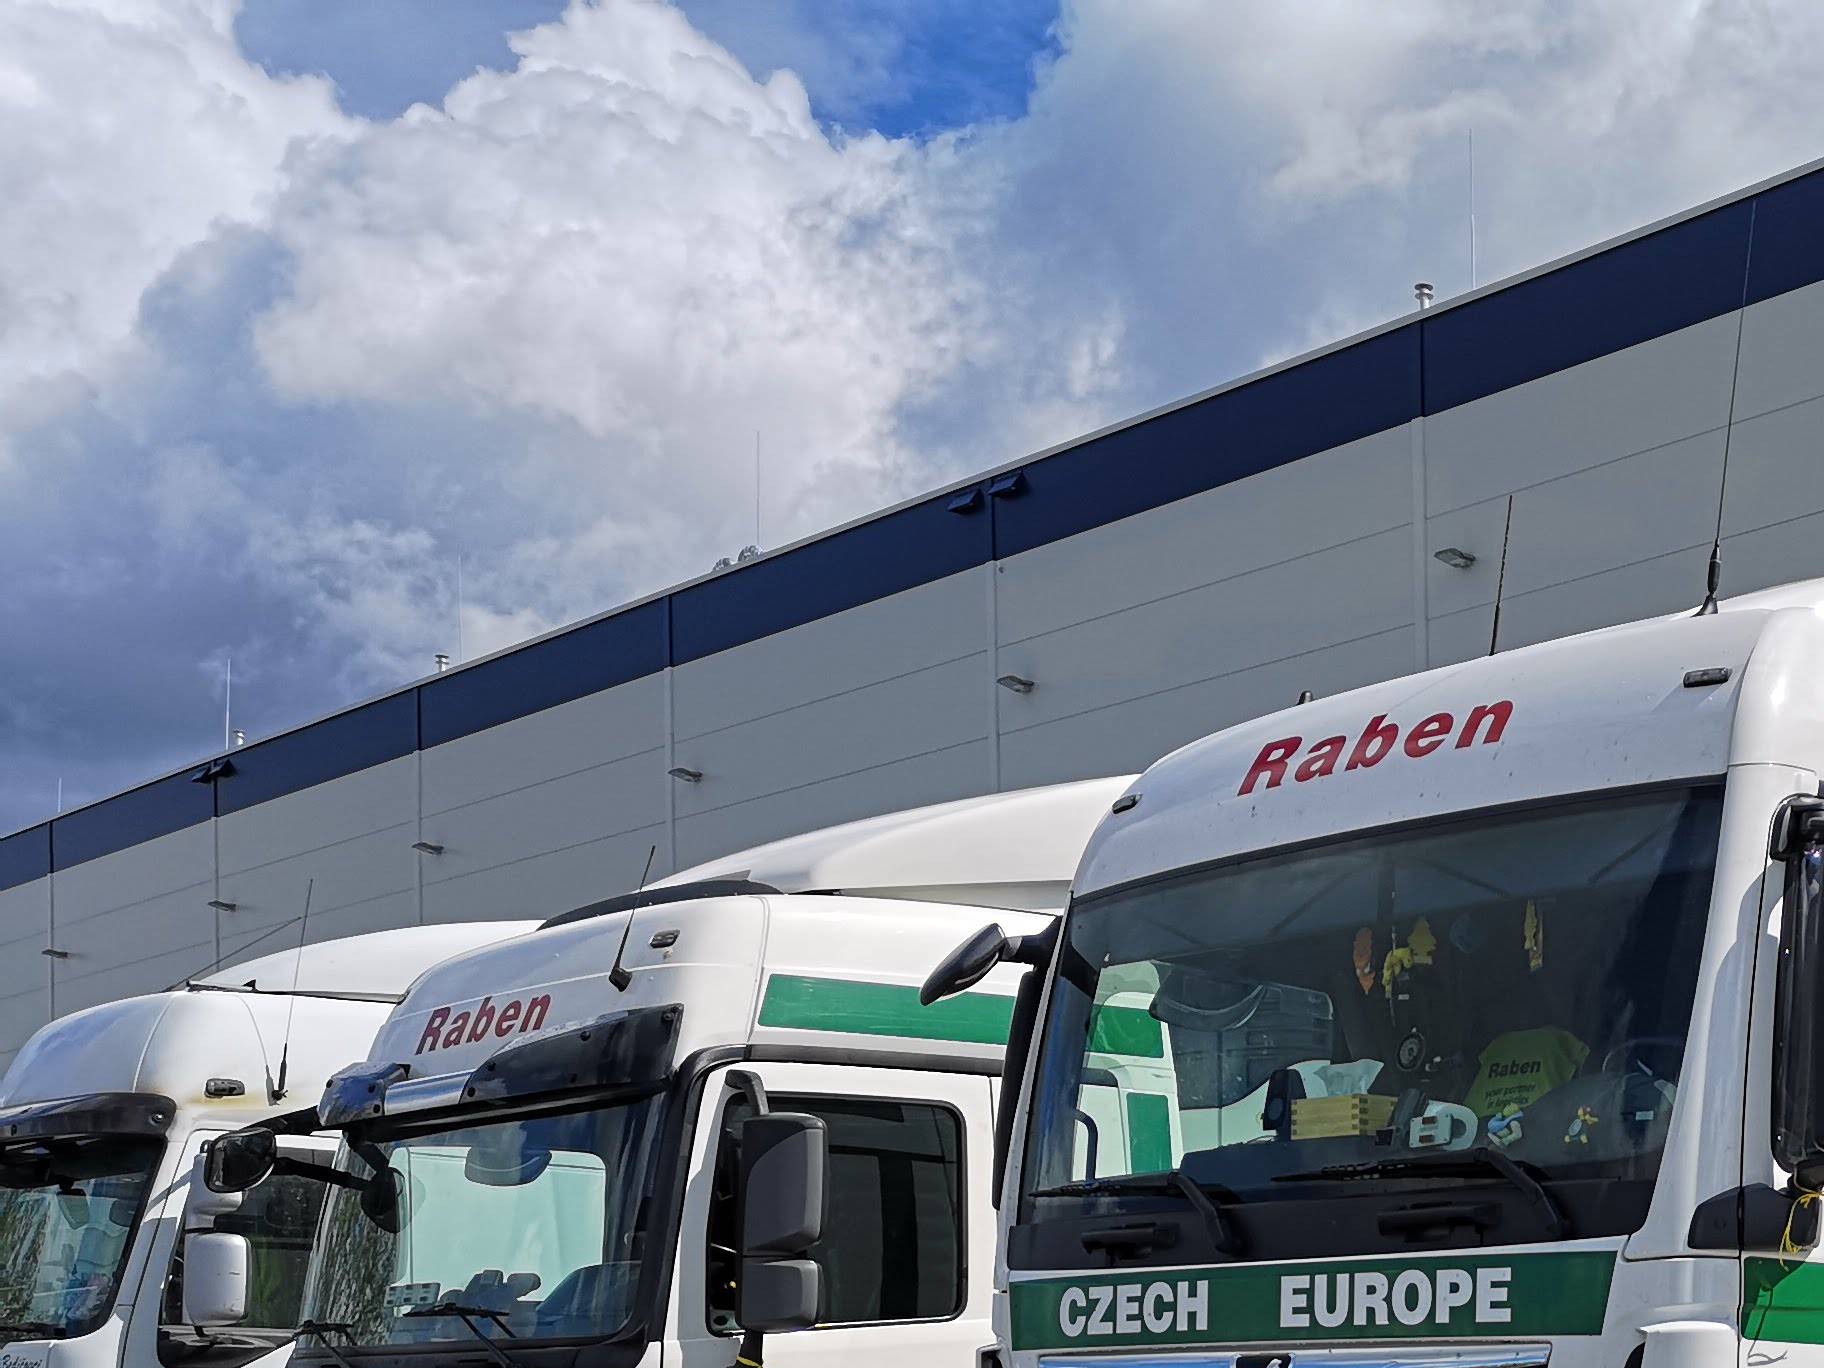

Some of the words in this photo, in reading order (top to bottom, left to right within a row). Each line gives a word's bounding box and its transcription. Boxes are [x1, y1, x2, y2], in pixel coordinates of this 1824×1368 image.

[1236, 699, 1514, 798] Raben
[413, 993, 552, 1056] Raben
[1487, 1059, 1542, 1080] Raben
[1059, 1278, 1209, 1338] CZECH
[1279, 1266, 1513, 1329] EUROPE
